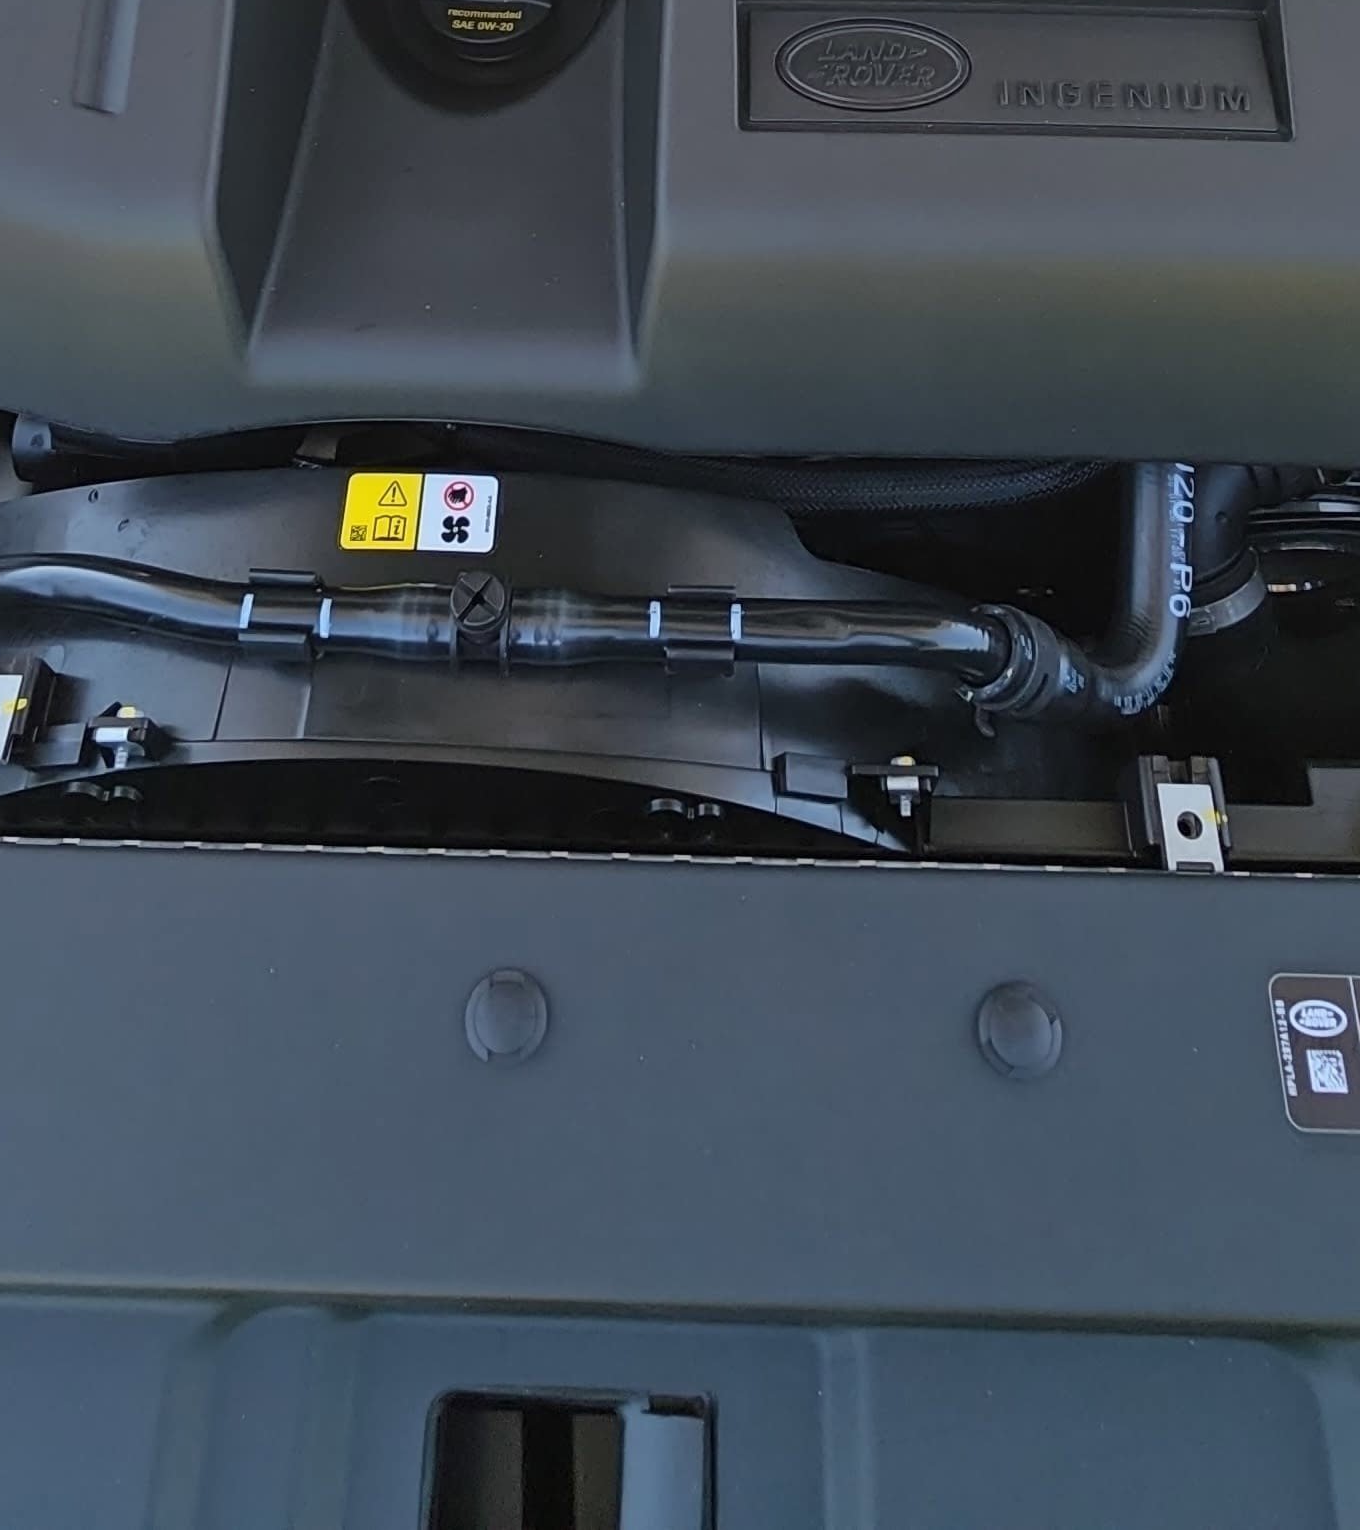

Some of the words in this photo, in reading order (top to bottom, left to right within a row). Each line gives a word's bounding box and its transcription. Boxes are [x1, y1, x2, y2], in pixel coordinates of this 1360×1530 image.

[447, 8, 522, 20] recommended
[451, 20, 475, 30] SAE
[477, 21, 514, 32] 0W-20
[826, 64, 936, 87] ROVER
[996, 77, 1252, 111] INGENIUM
